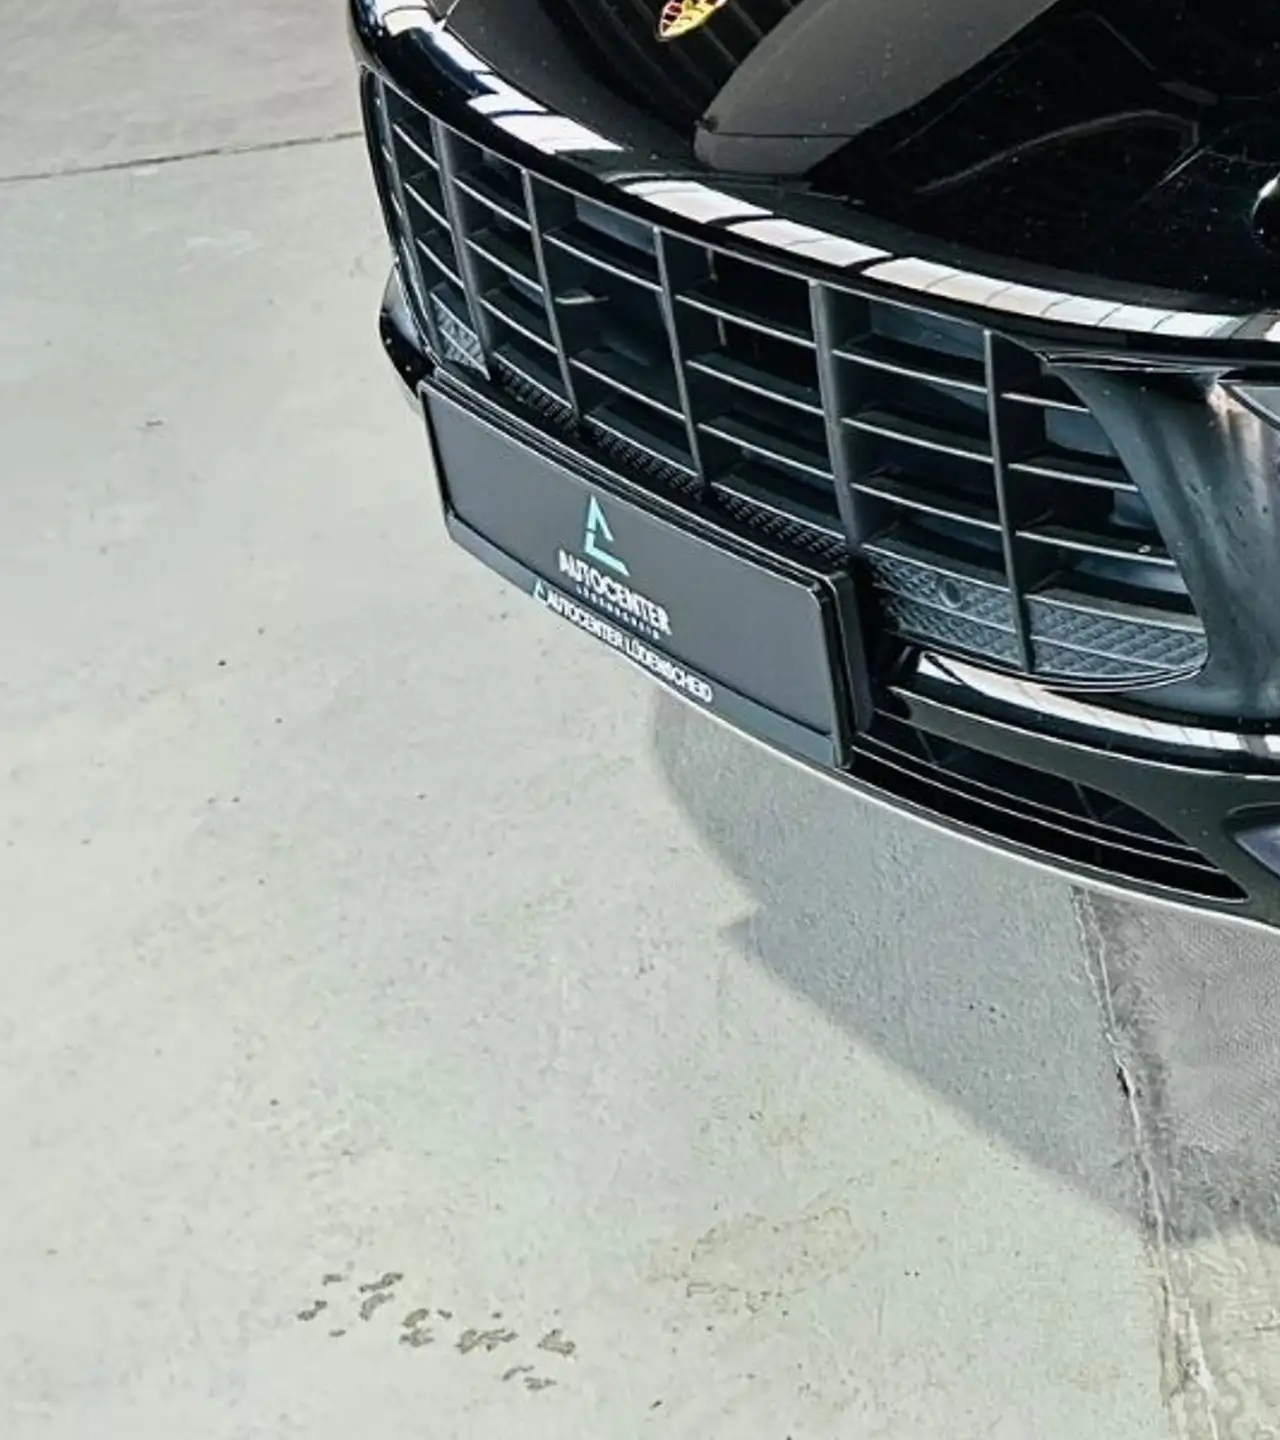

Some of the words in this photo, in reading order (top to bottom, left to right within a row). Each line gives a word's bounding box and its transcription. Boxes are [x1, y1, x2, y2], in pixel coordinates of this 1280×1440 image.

[558, 548, 673, 636] AUTOCENTER
[548, 589, 624, 649] AUTOCENTER
[625, 637, 713, 703] LÜDENSCHEID
